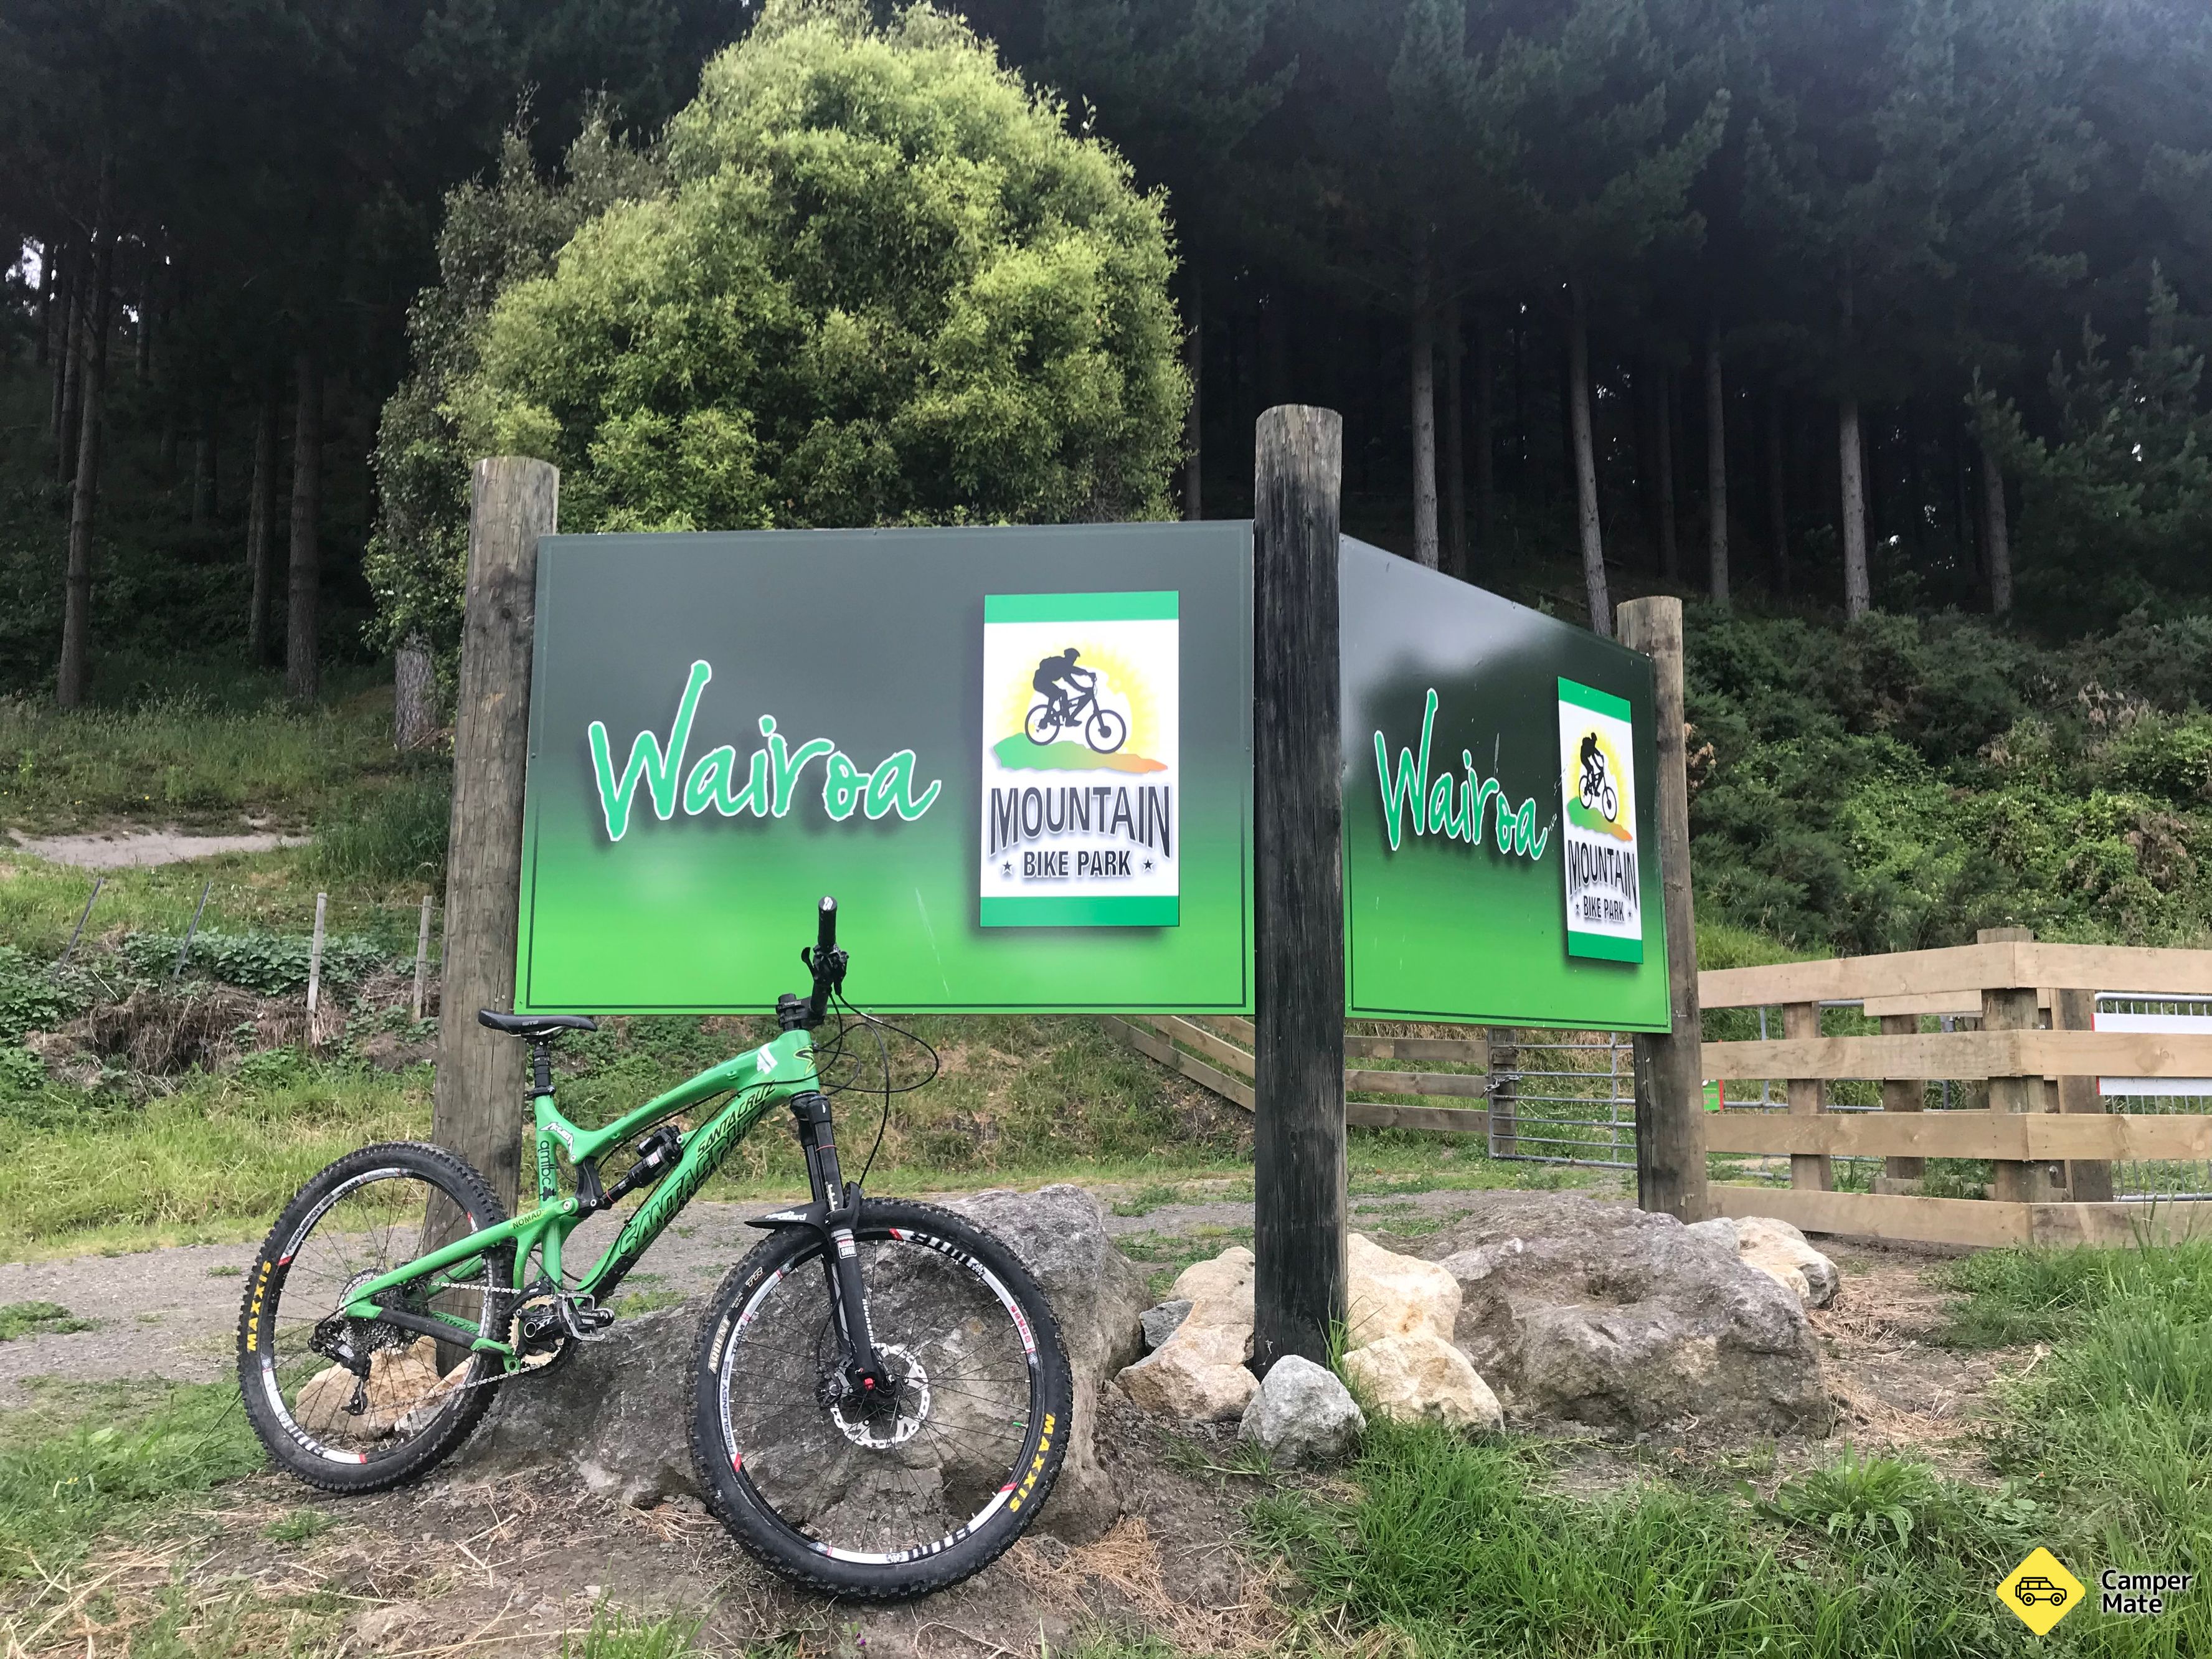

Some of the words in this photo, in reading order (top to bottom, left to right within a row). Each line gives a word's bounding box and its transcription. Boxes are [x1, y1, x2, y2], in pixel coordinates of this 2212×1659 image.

[588, 659, 942, 842] Wairoa
[1374, 688, 1548, 860] Wairoa
[990, 786, 1170, 858] MOUNTAIN
[1023, 851, 1069, 876] BIKE
[1077, 850, 1131, 876] PARK
[1568, 839, 1637, 909] MOUNTAIN
[1584, 896, 1601, 918] BIKE
[1604, 899, 1624, 921] PARK
[513, 1209, 542, 1229] NOMAD
[247, 1260, 272, 1351] MAXXIS
[707, 1314, 731, 1374] ARDENT
[1009, 1412, 1056, 1513] MAXXIS
